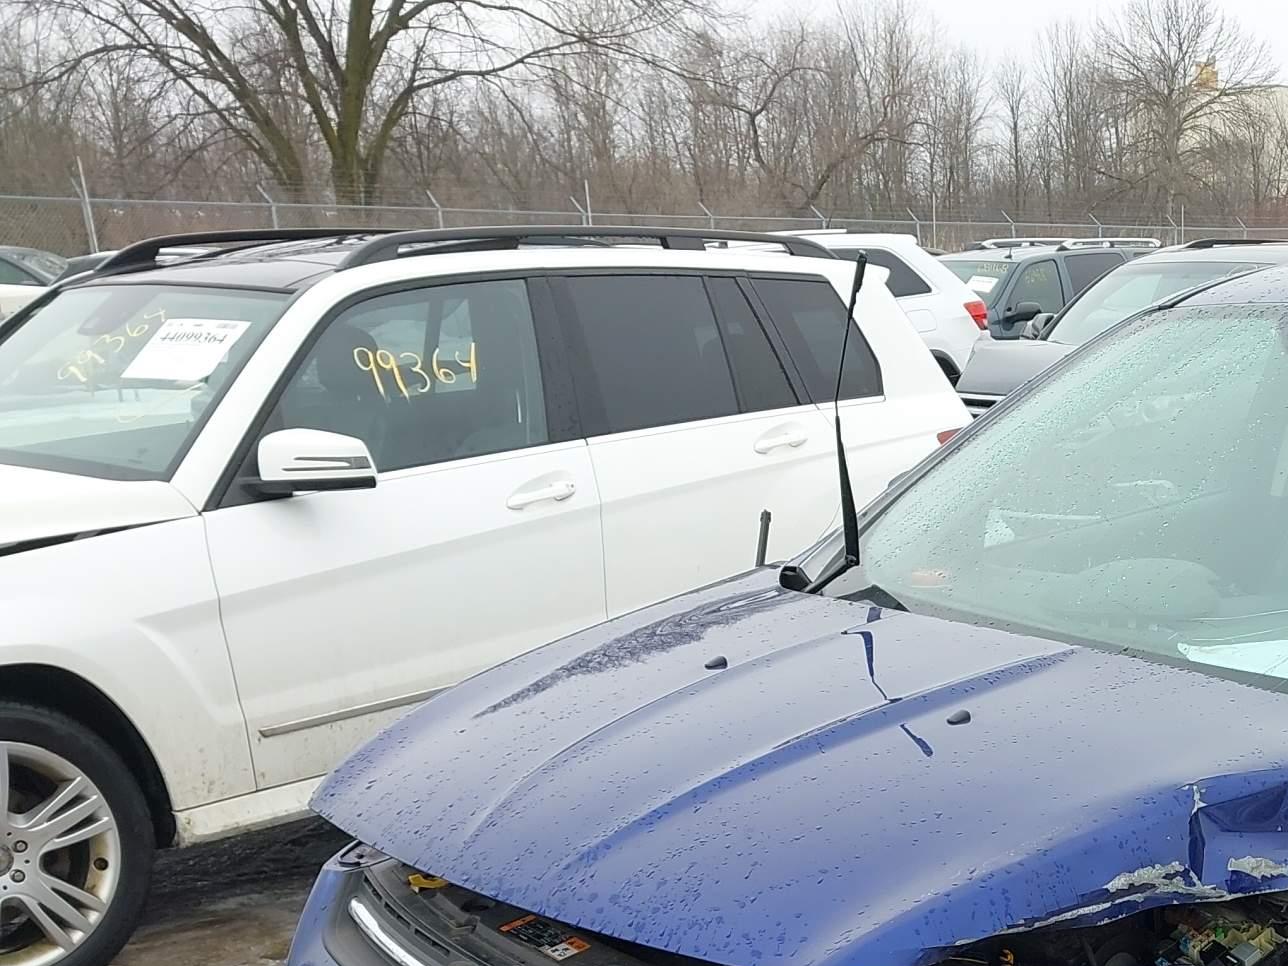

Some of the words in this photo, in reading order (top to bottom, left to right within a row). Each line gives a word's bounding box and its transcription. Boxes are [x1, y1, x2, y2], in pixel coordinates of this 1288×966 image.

[57, 307, 168, 382] 99364
[160, 331, 228, 345] 44099364
[353, 341, 477, 400] 99364
